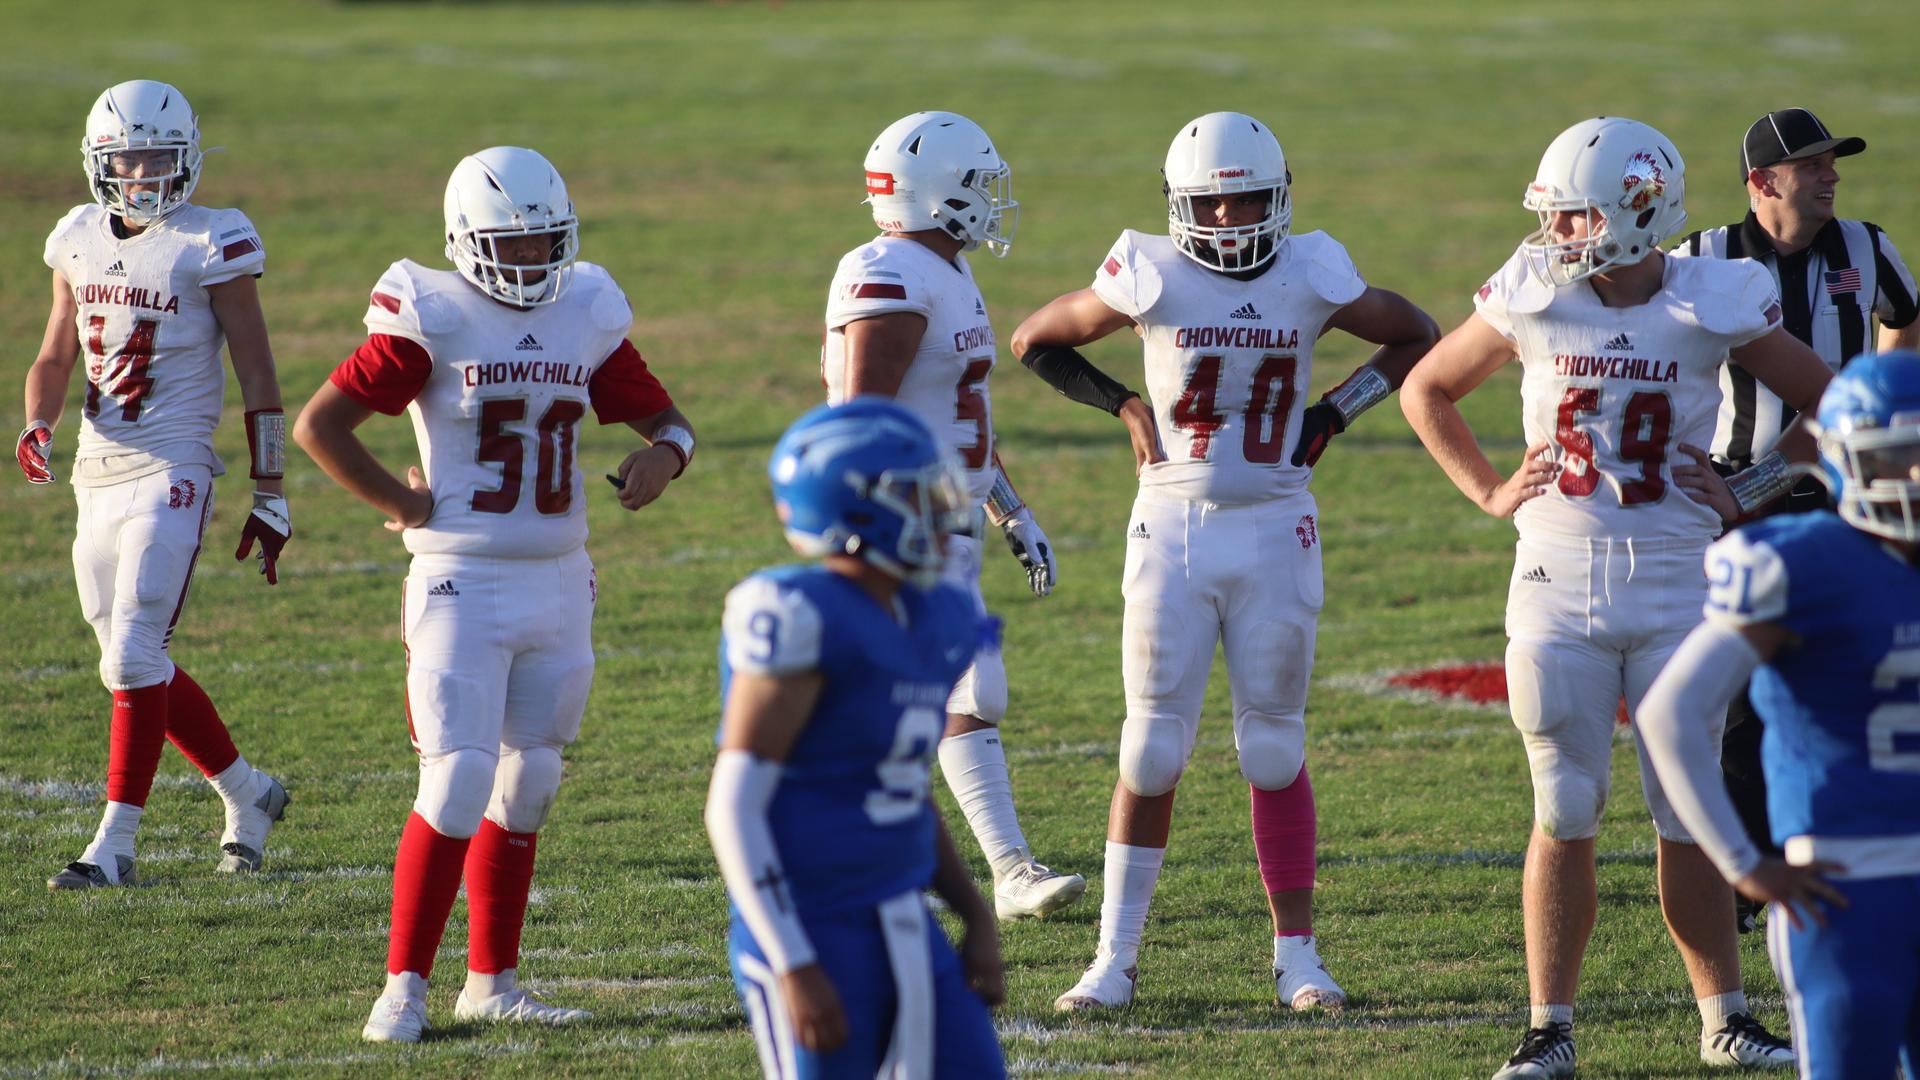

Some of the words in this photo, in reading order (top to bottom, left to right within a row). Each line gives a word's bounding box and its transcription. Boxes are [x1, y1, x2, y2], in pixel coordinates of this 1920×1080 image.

[1218, 169, 1245, 179] Riddell
[75, 284, 180, 315] CHOWCHILLA
[1230, 311, 1262, 320] adidas
[1175, 327, 1299, 349] CHOWCHILLA
[1604, 341, 1635, 351] adidas
[86, 315, 158, 422] 14
[1555, 354, 1679, 382] CHOWCHILLA
[1173, 355, 1298, 465] 40
[471, 397, 586, 516] 50
[1555, 386, 1672, 505] 59
[1521, 573, 1552, 583] adidas
[1706, 559, 1755, 613] 21
[749, 610, 778, 664] 9
[865, 705, 941, 826] 9
